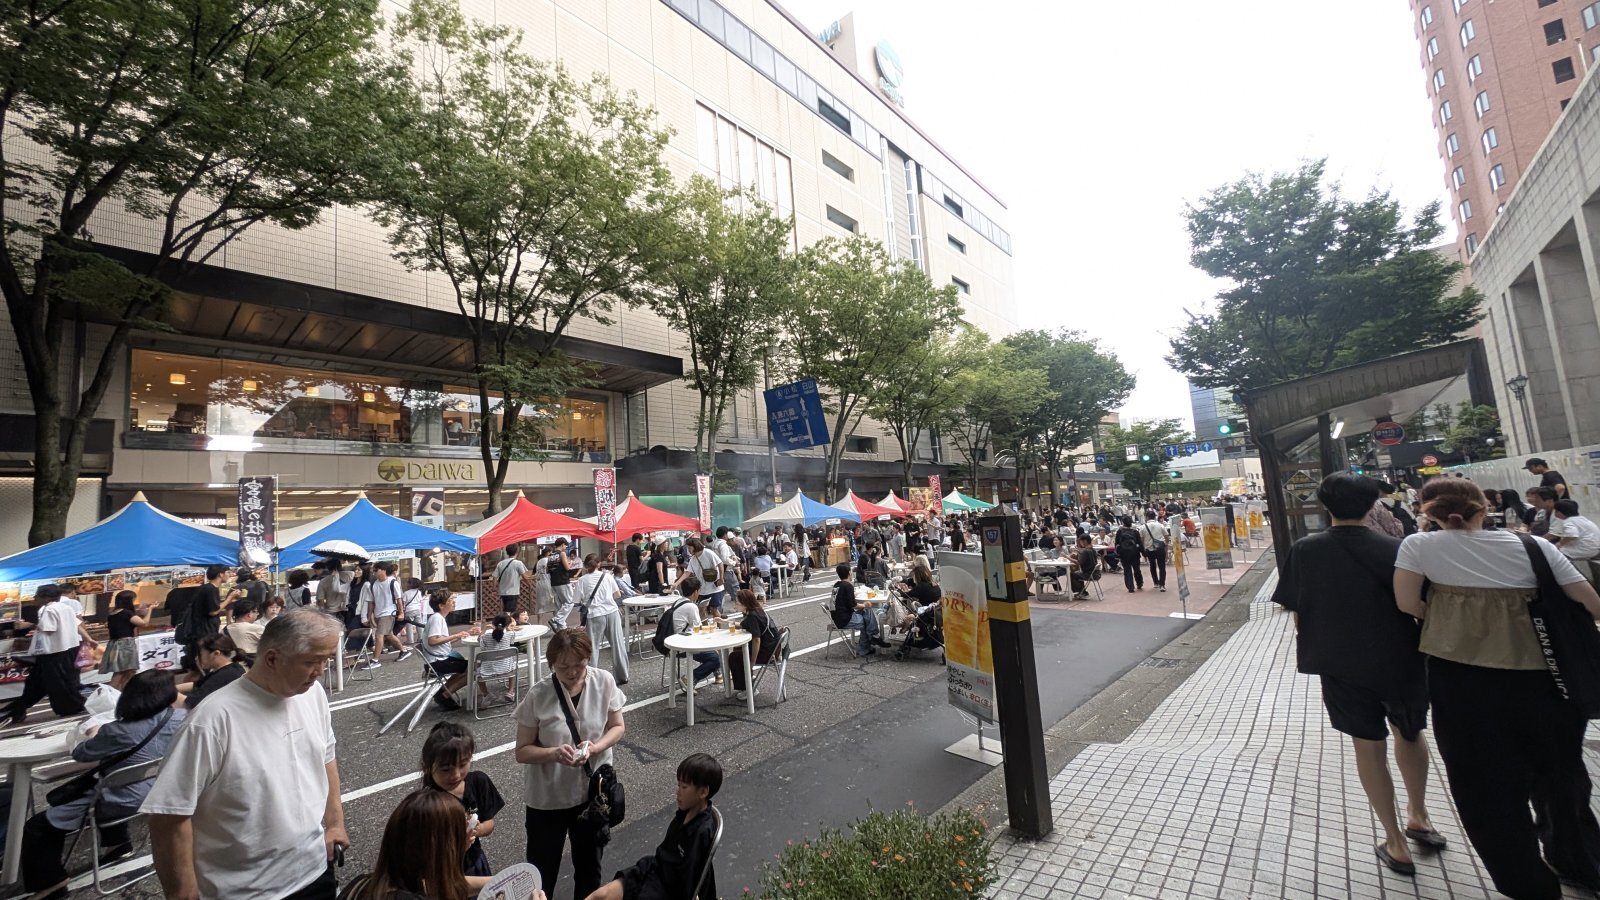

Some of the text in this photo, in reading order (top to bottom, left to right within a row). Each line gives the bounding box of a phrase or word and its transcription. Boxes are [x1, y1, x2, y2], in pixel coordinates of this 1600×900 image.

[987, 530, 997, 539] 157
[993, 572, 999, 590] 1
[945, 590, 964, 598] SUPER
[1533, 617, 1551, 646] DEAN
[1542, 647, 1554, 656] &
